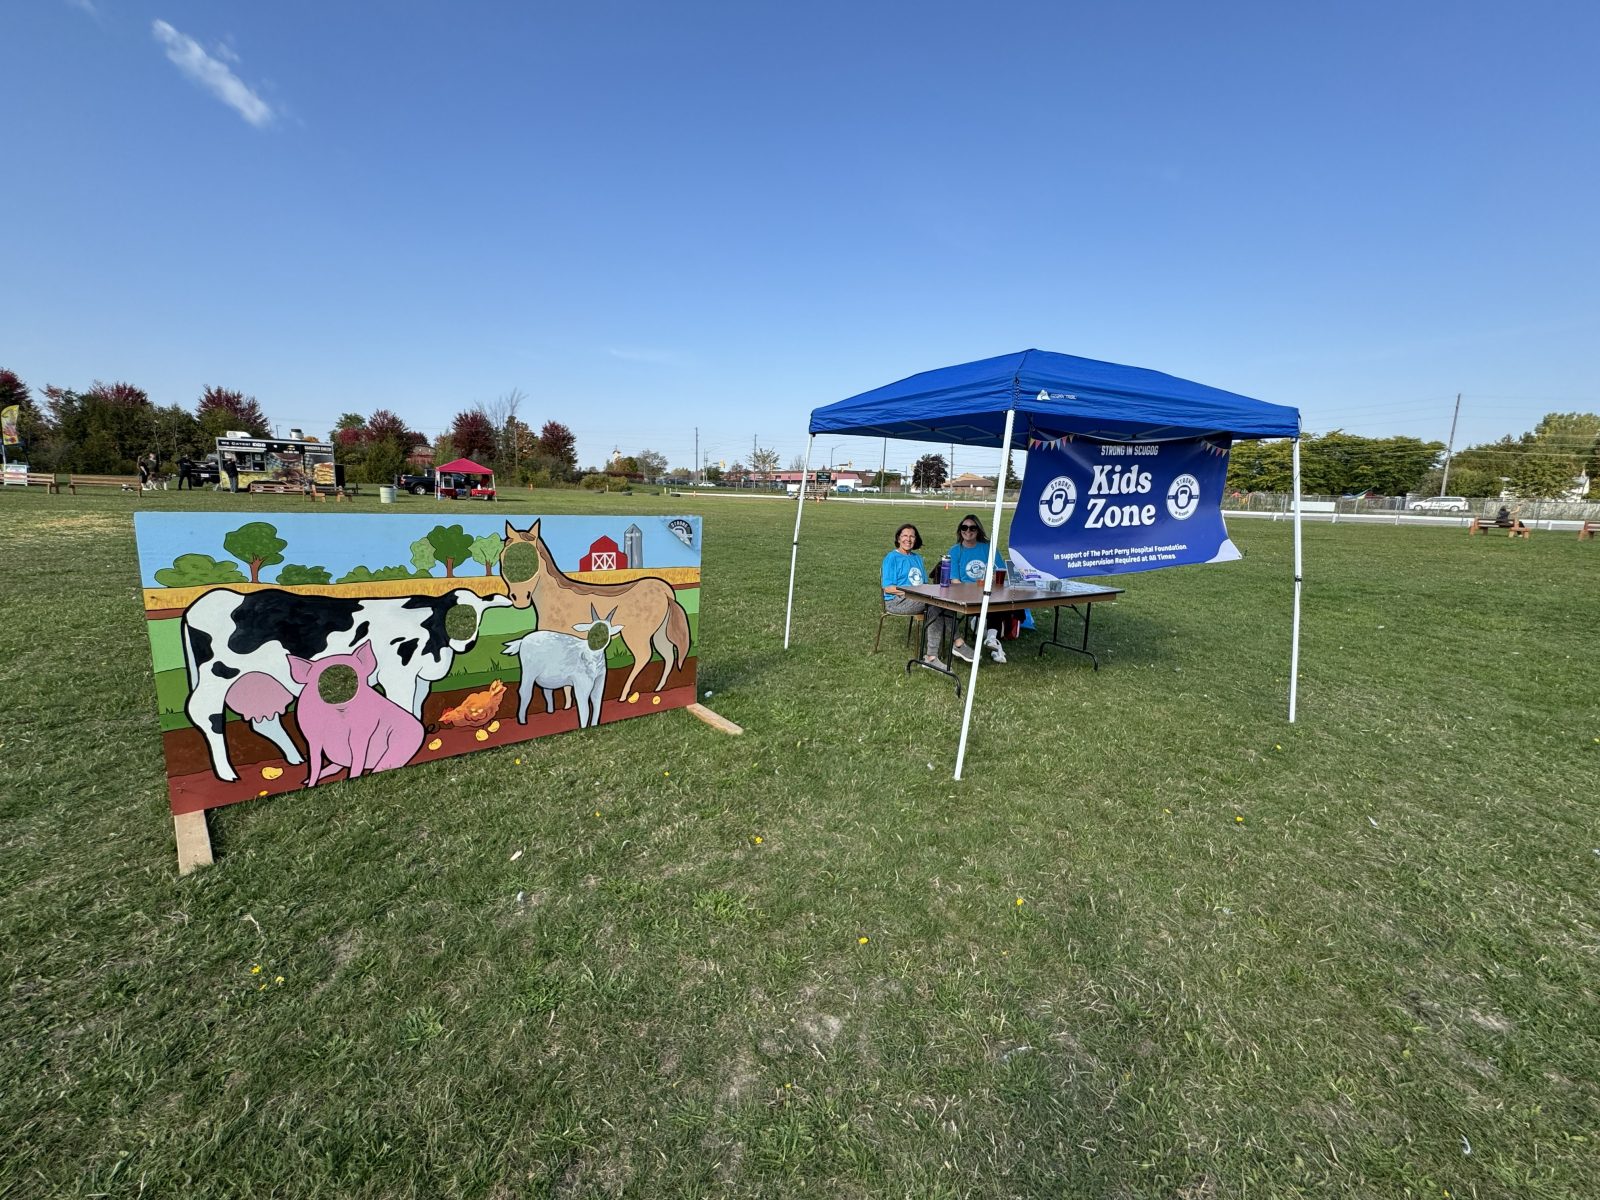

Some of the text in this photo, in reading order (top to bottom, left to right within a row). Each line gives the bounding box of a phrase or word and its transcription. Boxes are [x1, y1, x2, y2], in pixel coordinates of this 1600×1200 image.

[1101, 445, 1159, 456] STRONG IN SCUGOG
[1050, 480, 1072, 491] STRONG
[1088, 464, 1152, 495] Kids
[1085, 498, 1156, 529] Zone
[1061, 551, 1083, 560] support
[1083, 550, 1090, 559] of
[1090, 550, 1101, 558] The
[1114, 548, 1130, 556] Perry
[1130, 545, 1154, 555] Hospital
[1154, 543, 1187, 552] Foundation
[1067, 560, 1082, 569] Adult
[1082, 557, 1115, 568] Supervision
[1114, 555, 1141, 565] Required
[1141, 554, 1149, 562] at
[1157, 552, 1176, 560] Times
